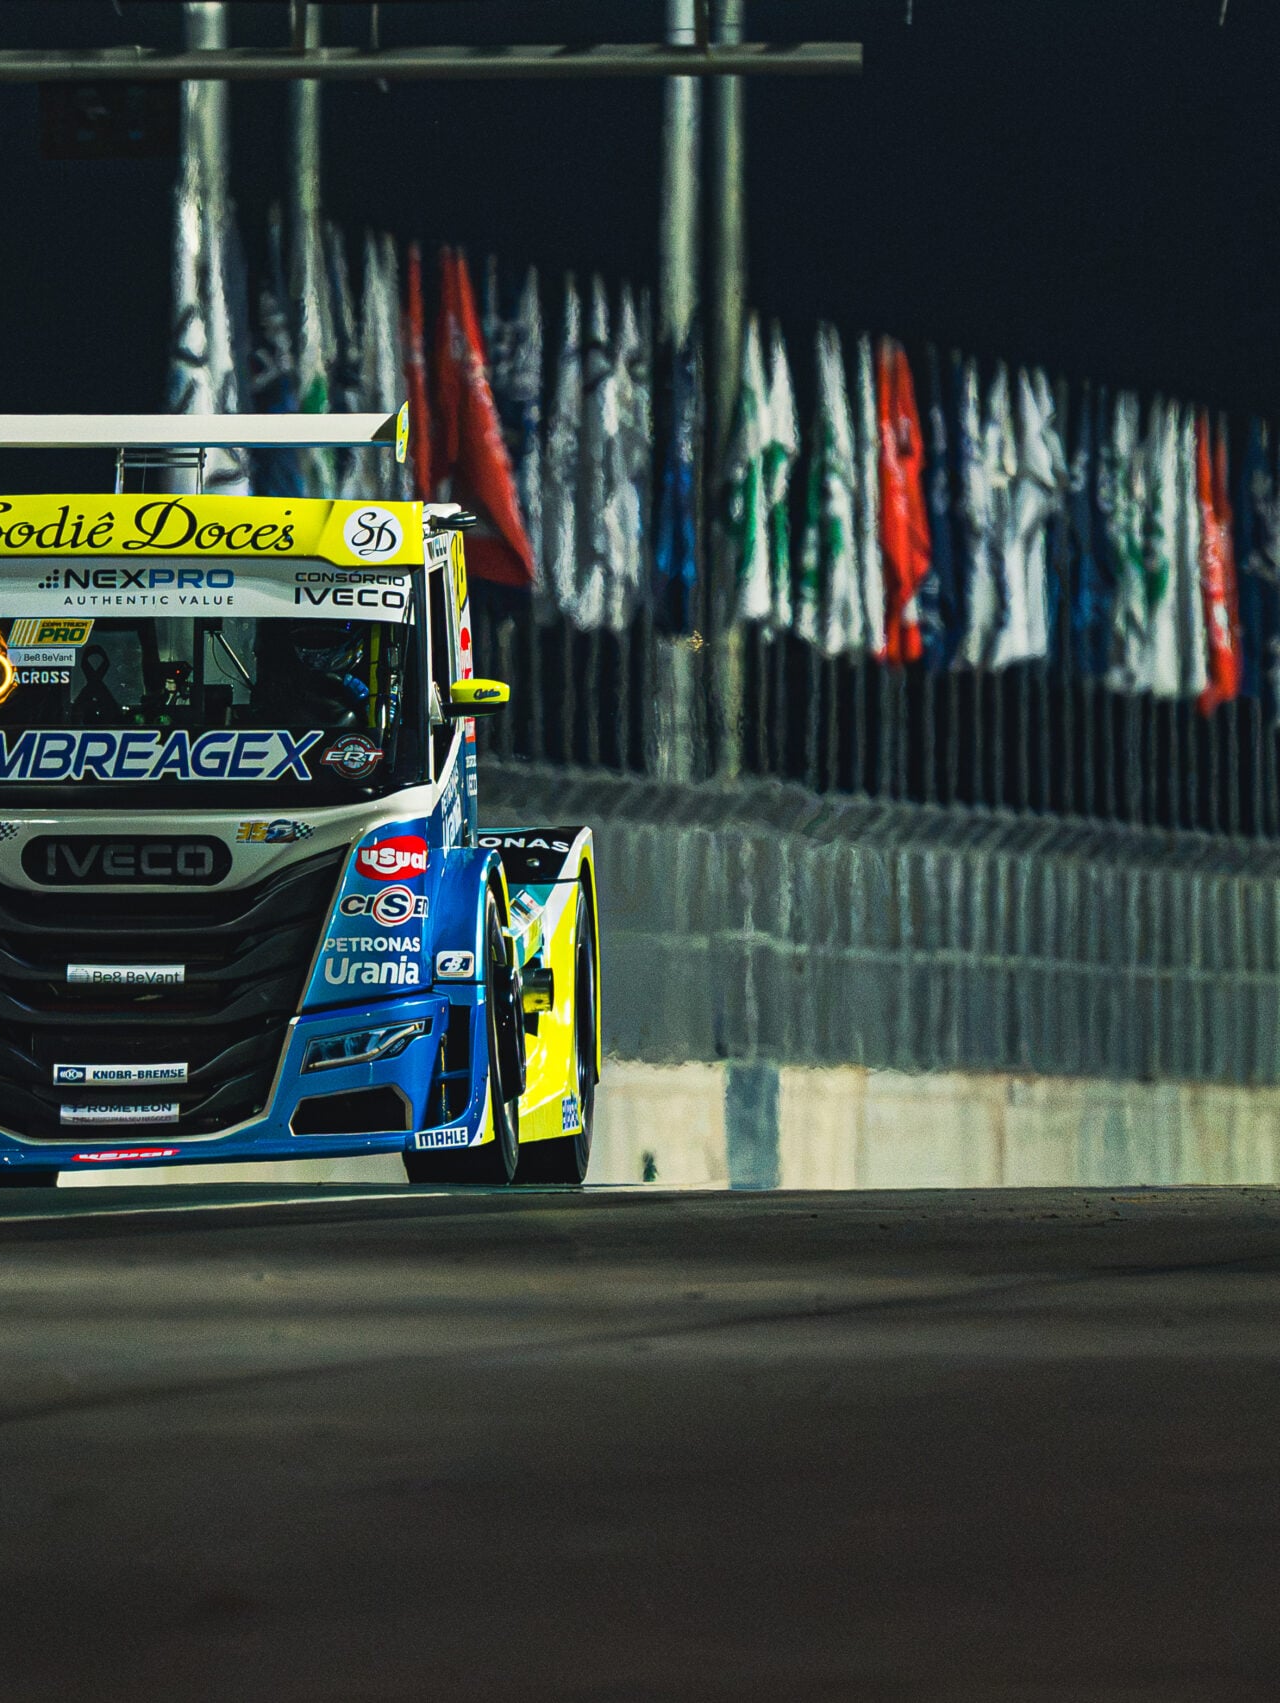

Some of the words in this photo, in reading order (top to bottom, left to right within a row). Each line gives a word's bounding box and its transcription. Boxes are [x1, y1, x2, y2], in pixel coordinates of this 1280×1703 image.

[122, 498, 295, 551] Doces
[64, 568, 235, 590] NEXPRO
[295, 570, 405, 587] CONSÓRCIO
[64, 595, 169, 606] AUTHENTIC
[179, 595, 234, 606] VALUE
[294, 587, 405, 609] IVECO
[38, 628, 86, 642] PRO
[42, 653, 73, 662] BeVant
[478, 836, 570, 853] ONAS
[47, 844, 214, 877] IVECO
[361, 847, 427, 874] usual
[325, 936, 420, 952] PETRONAS
[324, 955, 420, 985] Urania
[419, 1129, 467, 1147] MAHLE
